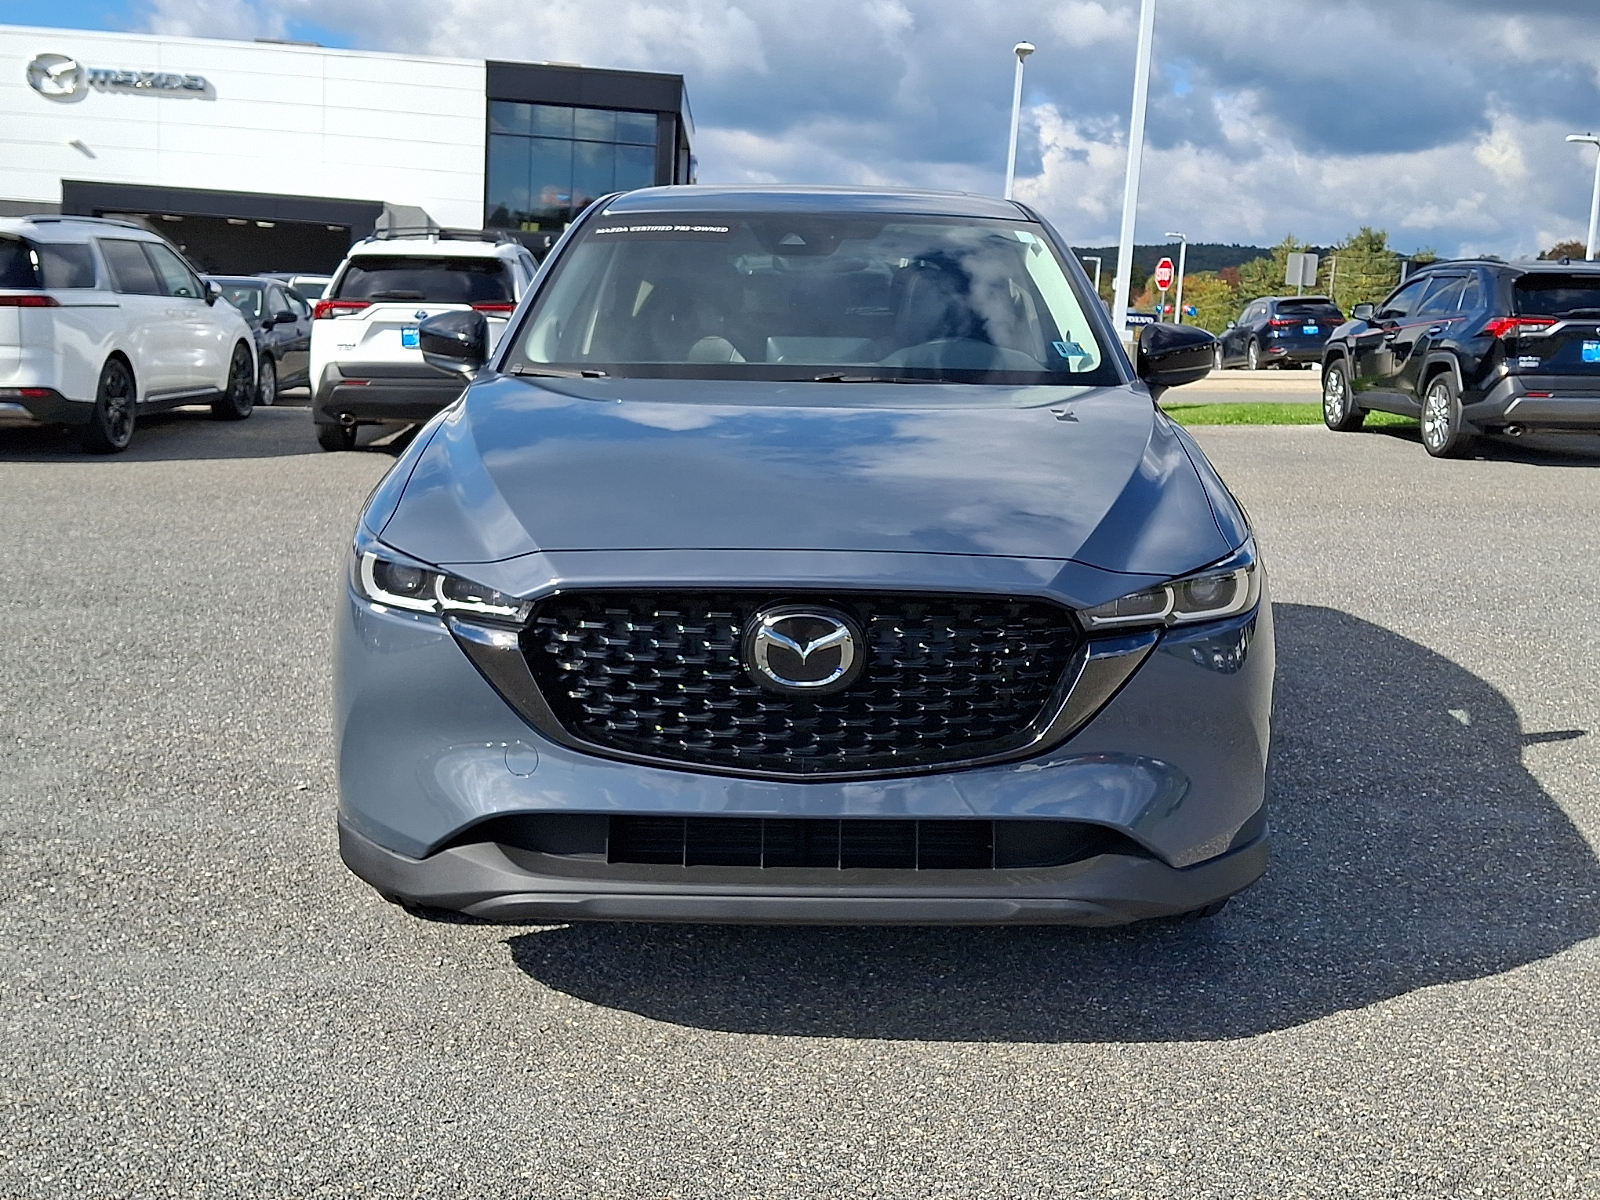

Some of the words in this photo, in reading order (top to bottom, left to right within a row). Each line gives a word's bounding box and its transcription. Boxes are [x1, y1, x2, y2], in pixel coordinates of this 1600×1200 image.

[595, 226, 628, 234] MAZDA
[674, 225, 729, 233] PRE-OWNED
[1157, 268, 1171, 280] STOP
